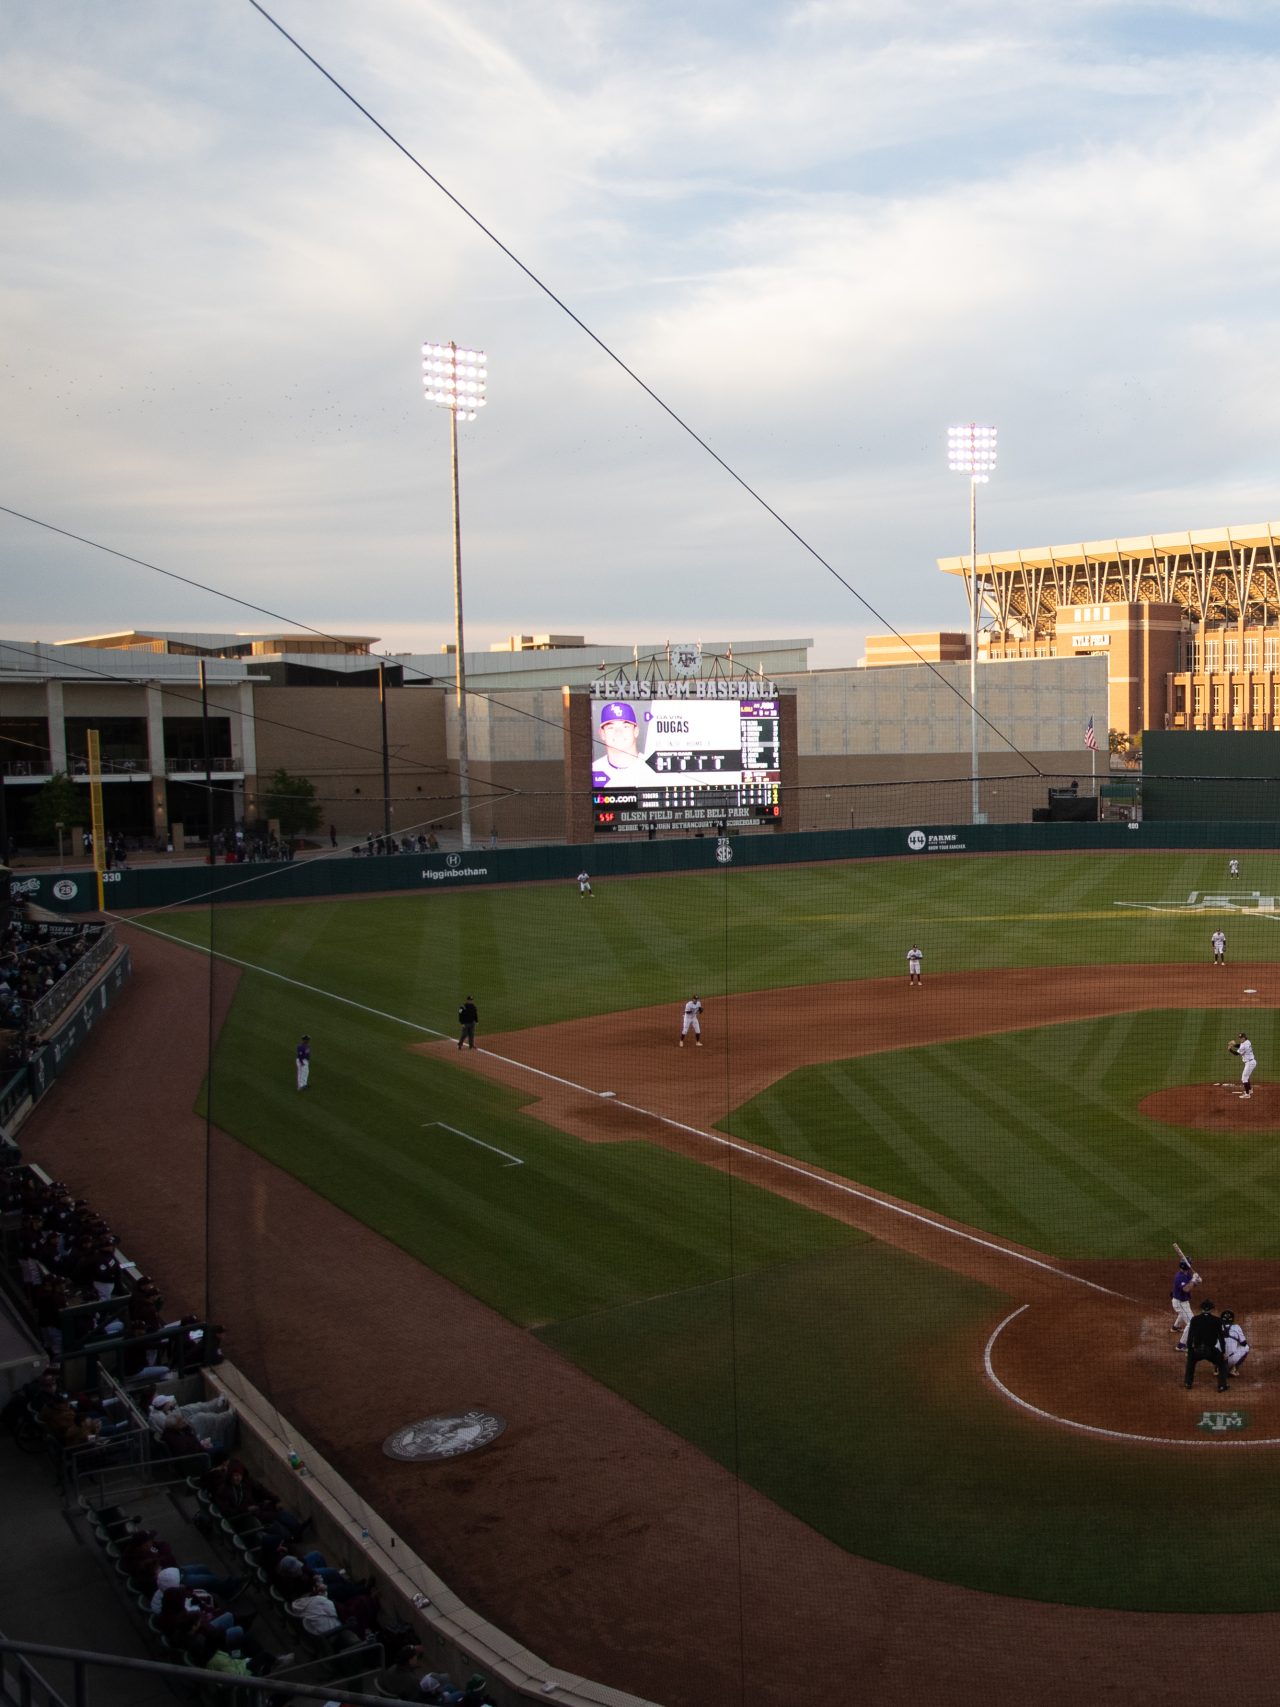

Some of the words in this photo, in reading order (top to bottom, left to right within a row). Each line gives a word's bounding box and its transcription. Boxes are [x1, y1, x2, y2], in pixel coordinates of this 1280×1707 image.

[591, 681, 650, 697] TEXAS
[657, 681, 690, 697] A&M
[697, 681, 778, 698] BASEBALL
[656, 721, 689, 733] DUGAS
[594, 793, 637, 804] ubeo.com
[621, 811, 647, 821] OLSEN
[649, 811, 672, 820] FIELD
[684, 808, 705, 819] BLUE
[707, 808, 726, 818] BELL
[727, 808, 749, 817] PARK
[103, 872, 121, 882] 330
[422, 868, 488, 880] Higginbotham
